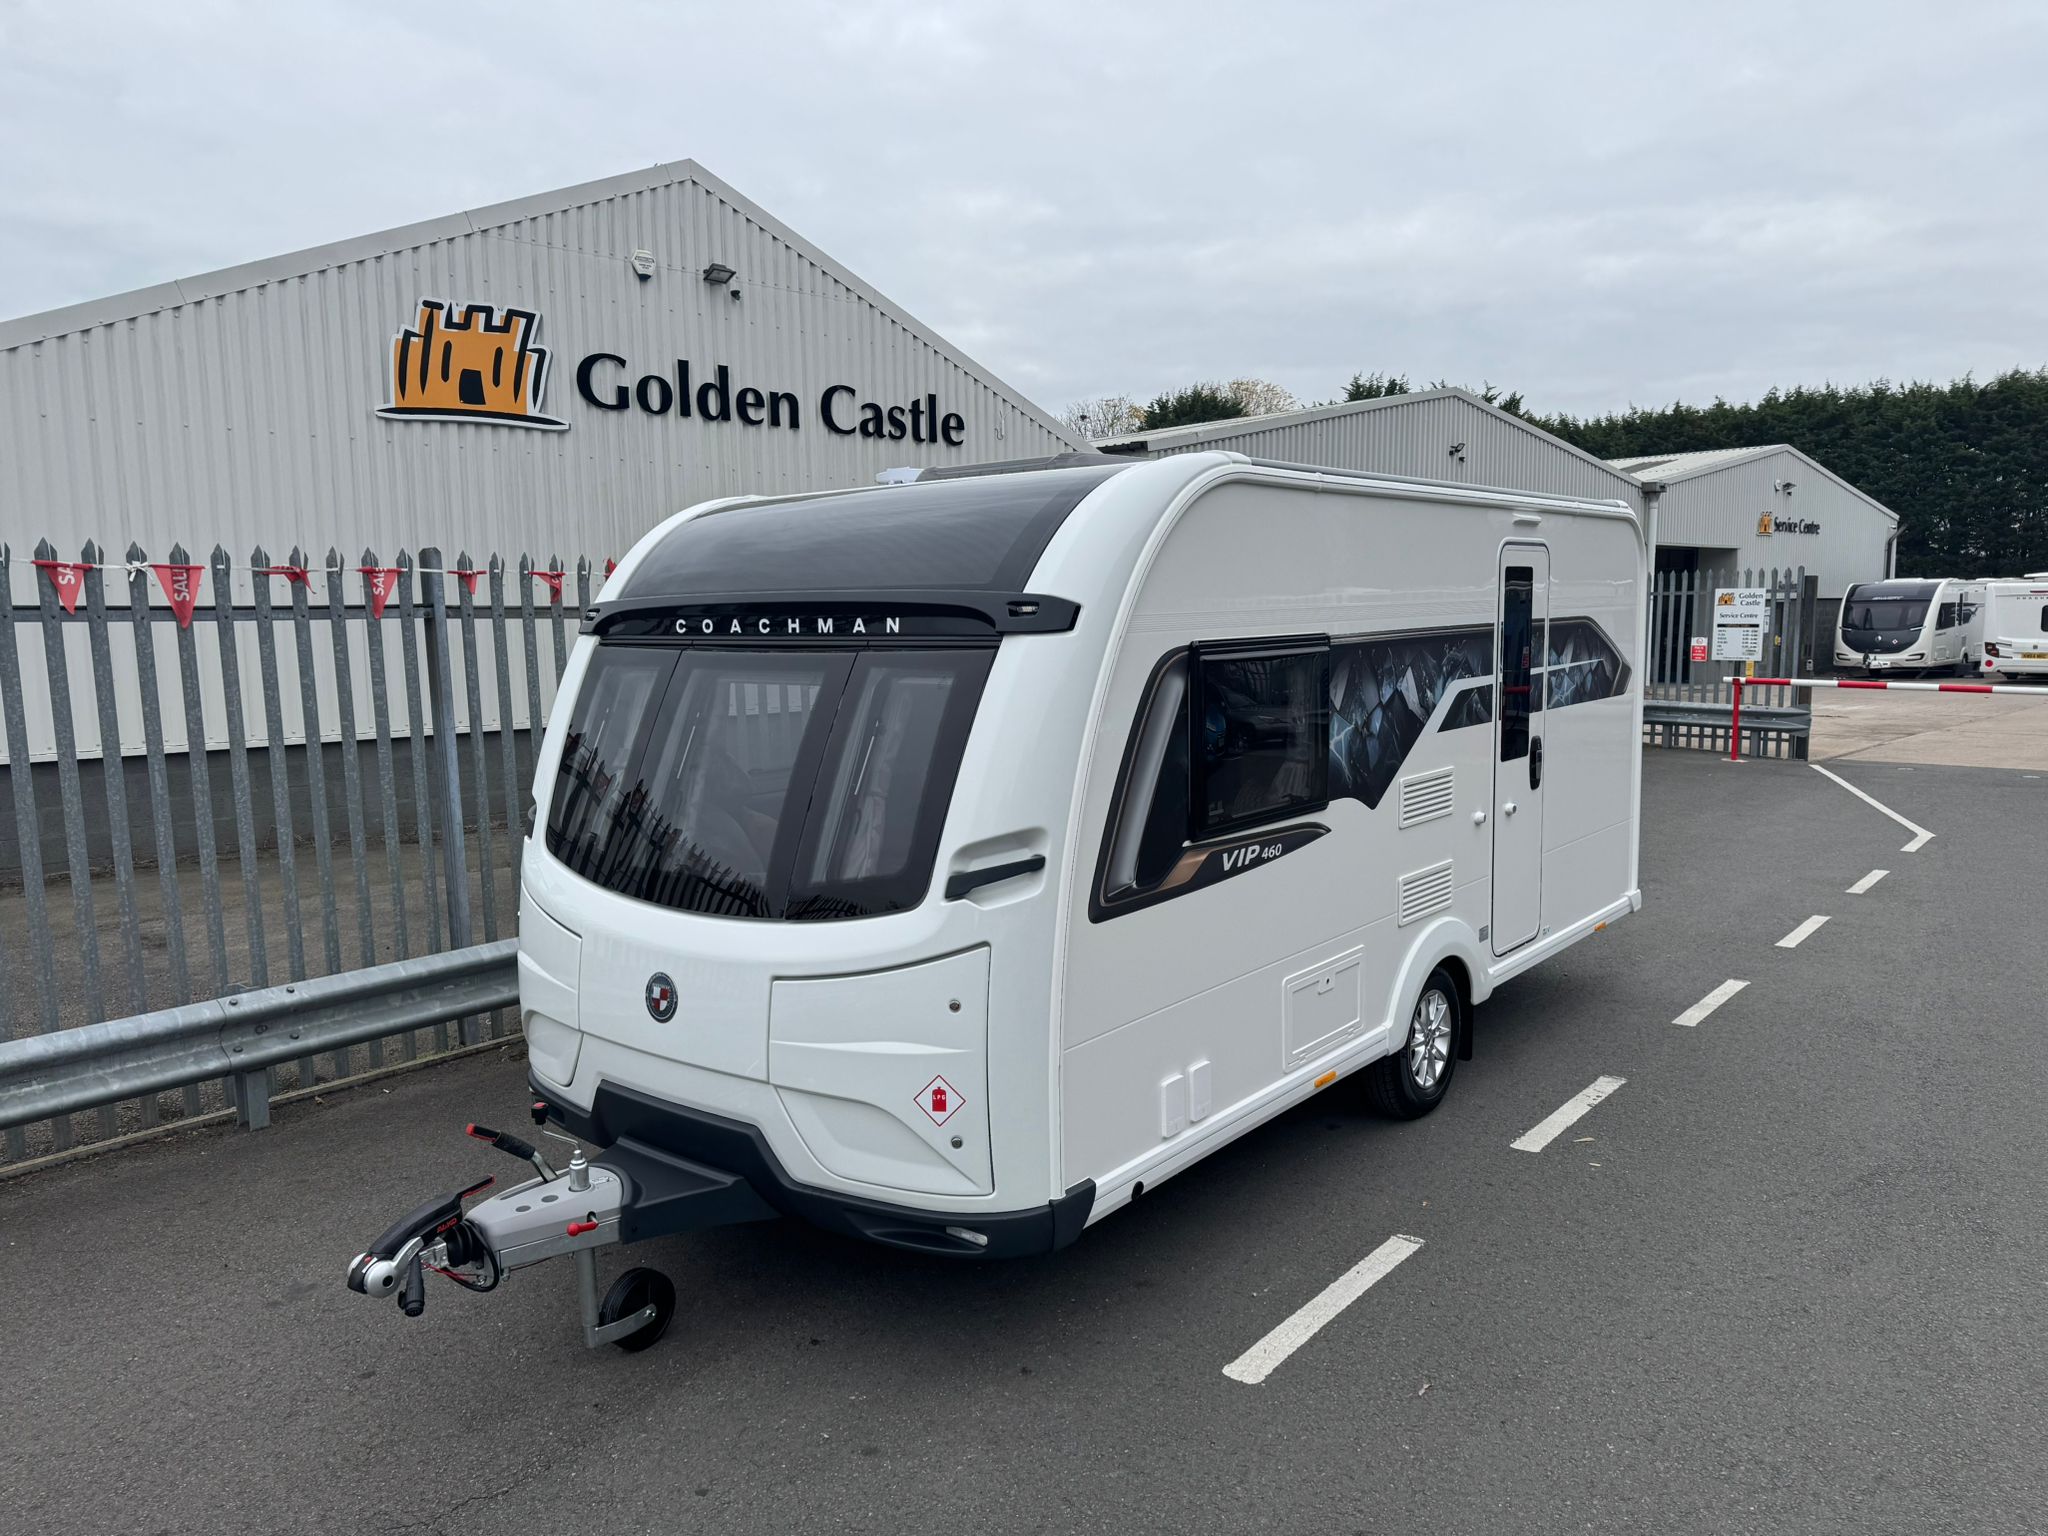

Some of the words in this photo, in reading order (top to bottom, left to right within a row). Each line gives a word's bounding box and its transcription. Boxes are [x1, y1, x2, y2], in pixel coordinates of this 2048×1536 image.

[576, 352, 800, 430] Golden
[820, 384, 966, 446] Castle
[1773, 516, 1798, 533] Service
[1798, 518, 1820, 535] Centre
[57, 566, 76, 585] SA
[676, 616, 900, 634] COACHMAN
[1222, 844, 1260, 871] VIP
[1261, 843, 1283, 860] 460
